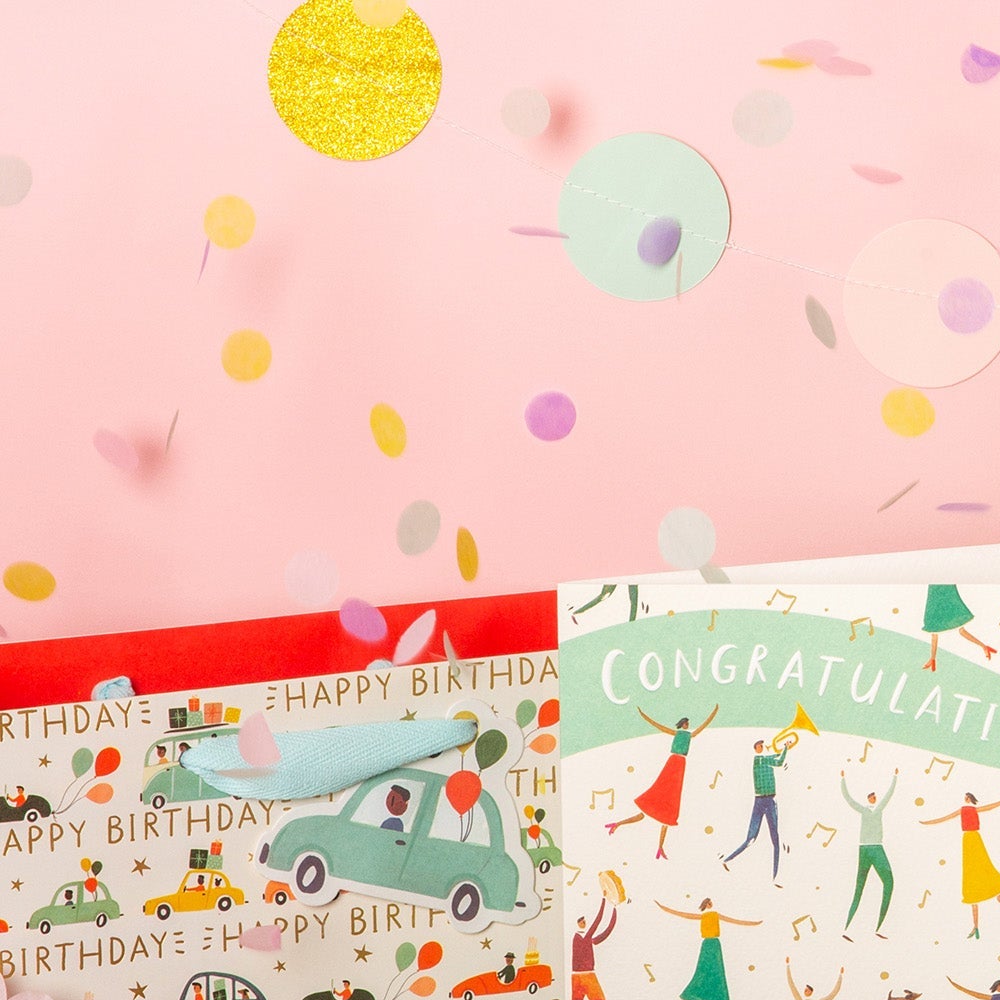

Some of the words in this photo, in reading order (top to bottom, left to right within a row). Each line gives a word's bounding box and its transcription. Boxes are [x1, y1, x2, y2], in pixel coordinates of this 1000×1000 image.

[285, 672, 392, 712] HAPPY
[107, 799, 275, 844] BIRTHDAY
[0, 931, 168, 978] BIRTHDAY
